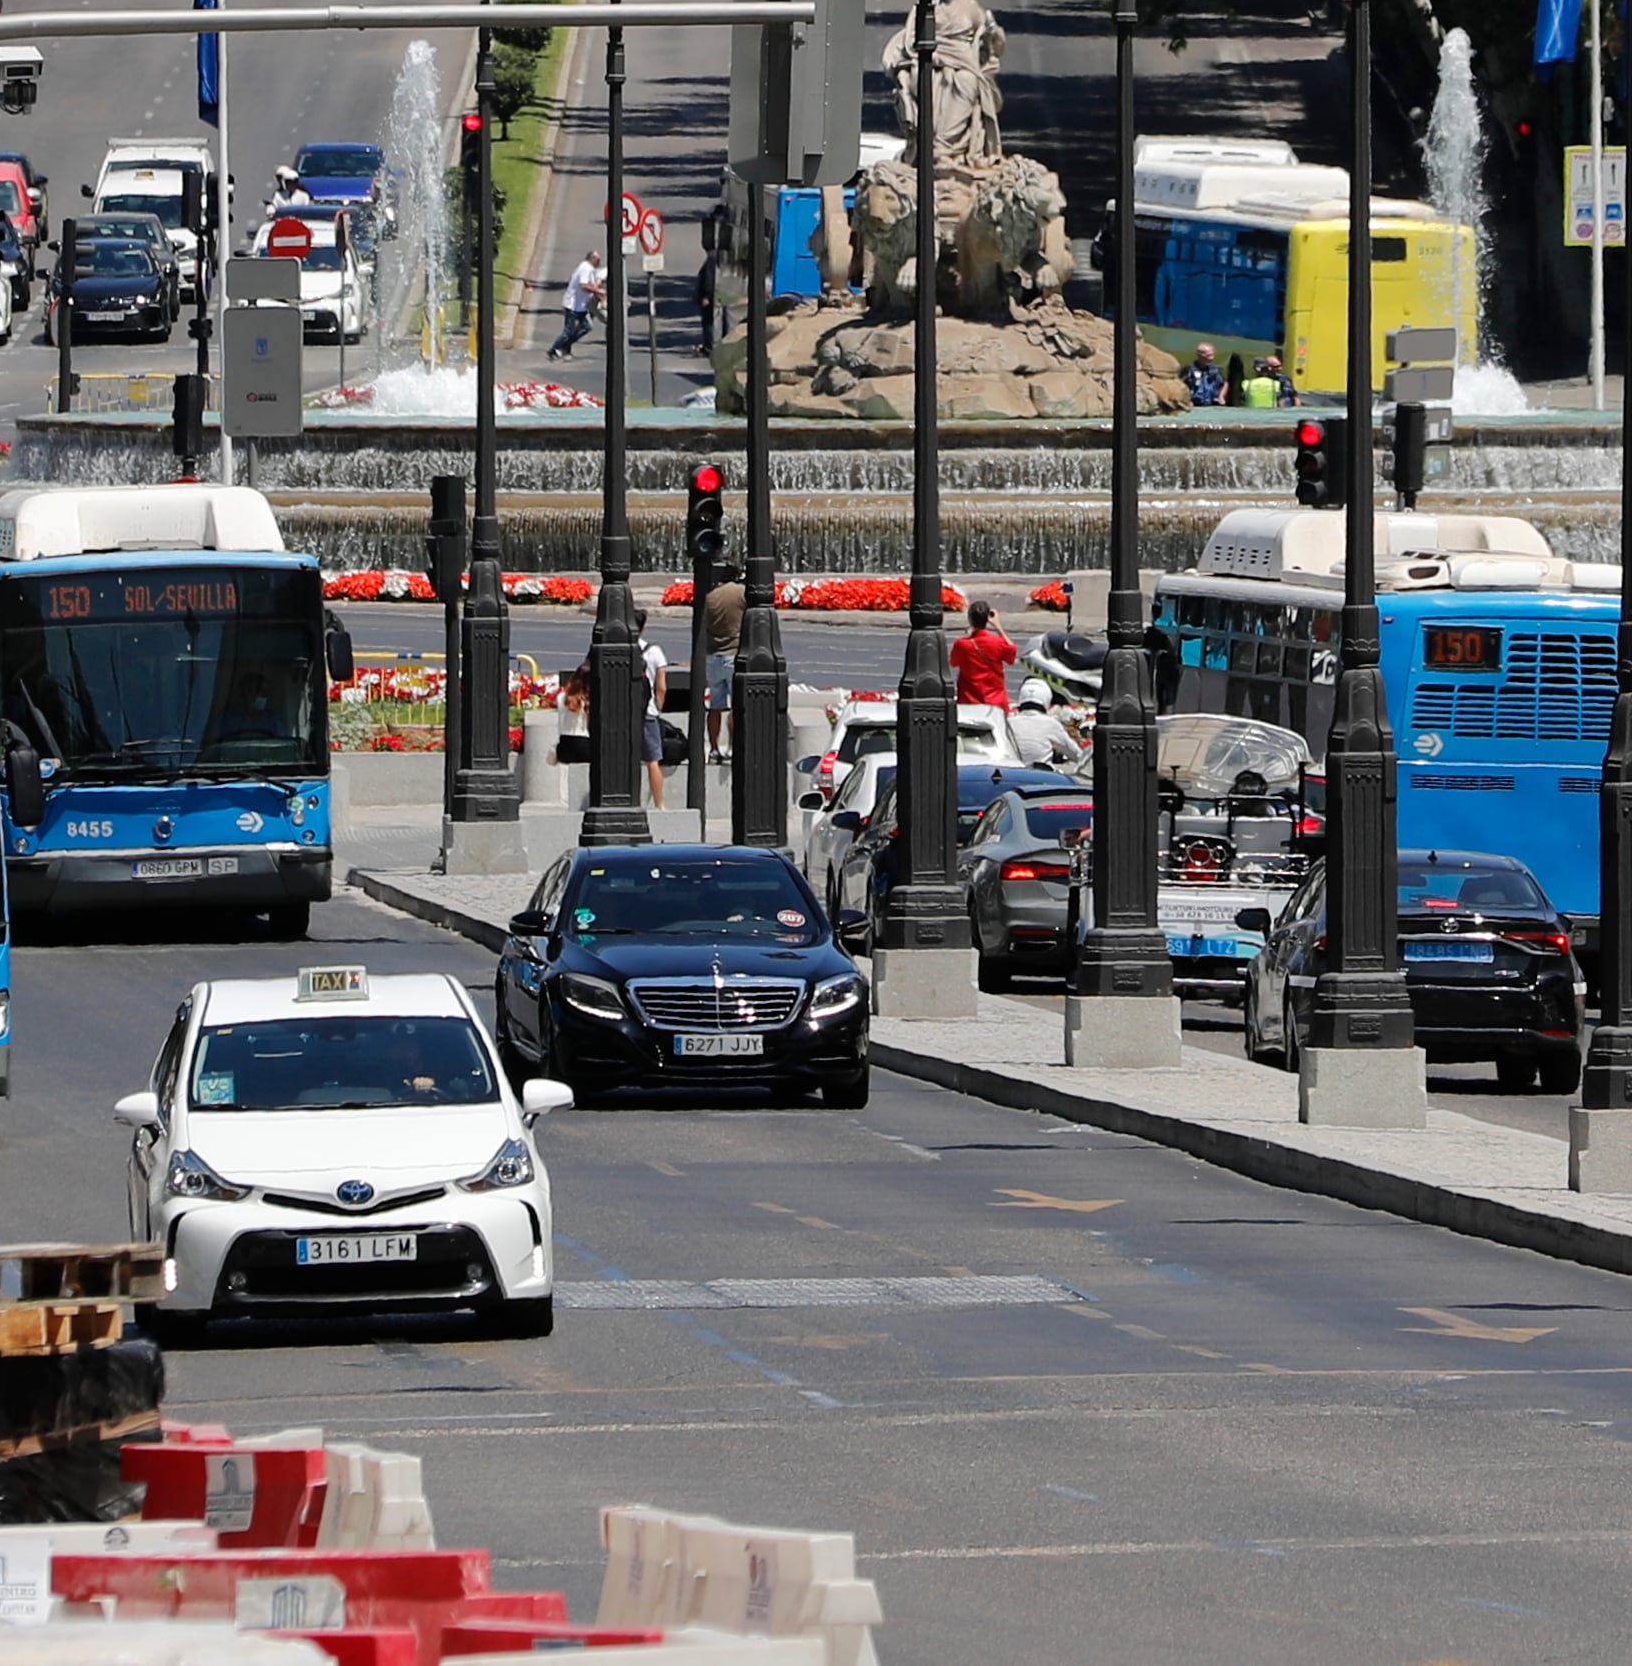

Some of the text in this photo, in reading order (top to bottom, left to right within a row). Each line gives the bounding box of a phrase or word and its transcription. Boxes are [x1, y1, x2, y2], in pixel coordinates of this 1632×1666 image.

[48, 583, 237, 618] 150 SOL/SEVILLA
[1433, 631, 1483, 663] 150
[66, 820, 114, 838] 8455
[140, 864, 170, 876] 0860
[211, 859, 236, 874] SP
[780, 912, 804, 924] 207
[685, 1038, 760, 1053] 6271 JJY
[310, 1238, 412, 1260] 3161 LFM
